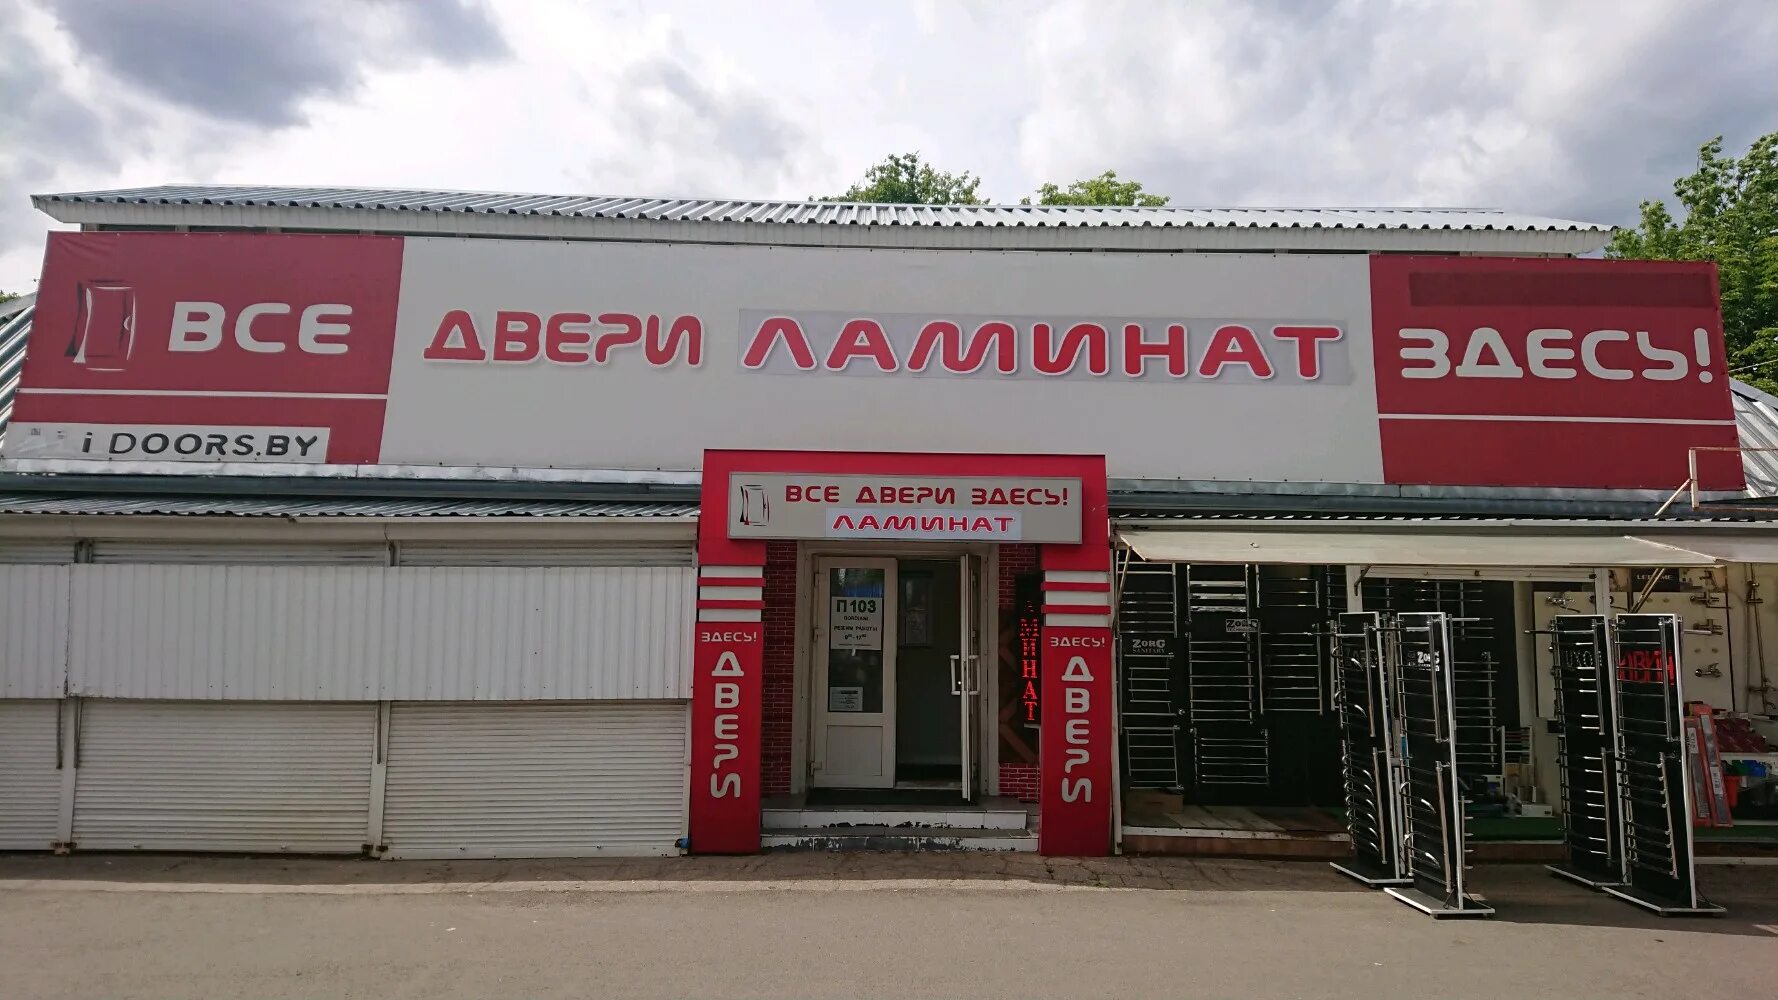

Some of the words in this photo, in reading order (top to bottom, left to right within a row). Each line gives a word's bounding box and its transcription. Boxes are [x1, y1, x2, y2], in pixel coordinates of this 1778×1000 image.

[168, 301, 353, 355] ВСЕ
[424, 309, 704, 367] ДВЕРИ
[741, 315, 1344, 381] ЛАМИНАТ
[1398, 327, 1713, 384] ЗДЕСЬ!
[109, 432, 318, 457] DOORS.BY
[785, 485, 840, 503] ВСЕ
[855, 486, 956, 504] ДВЕРИ
[971, 487, 1068, 506] ЗДЕСЬ!
[832, 514, 1014, 533] ЛАМИНАТ
[836, 599, 847, 613] П
[850, 599, 877, 613] 103
[701, 631, 757, 642] ЗДЕСЬ!
[1050, 636, 1105, 648] ЗДЕСЬ!
[710, 651, 745, 799] ДВЕРИ
[1061, 655, 1095, 804] ДВЕРИ
